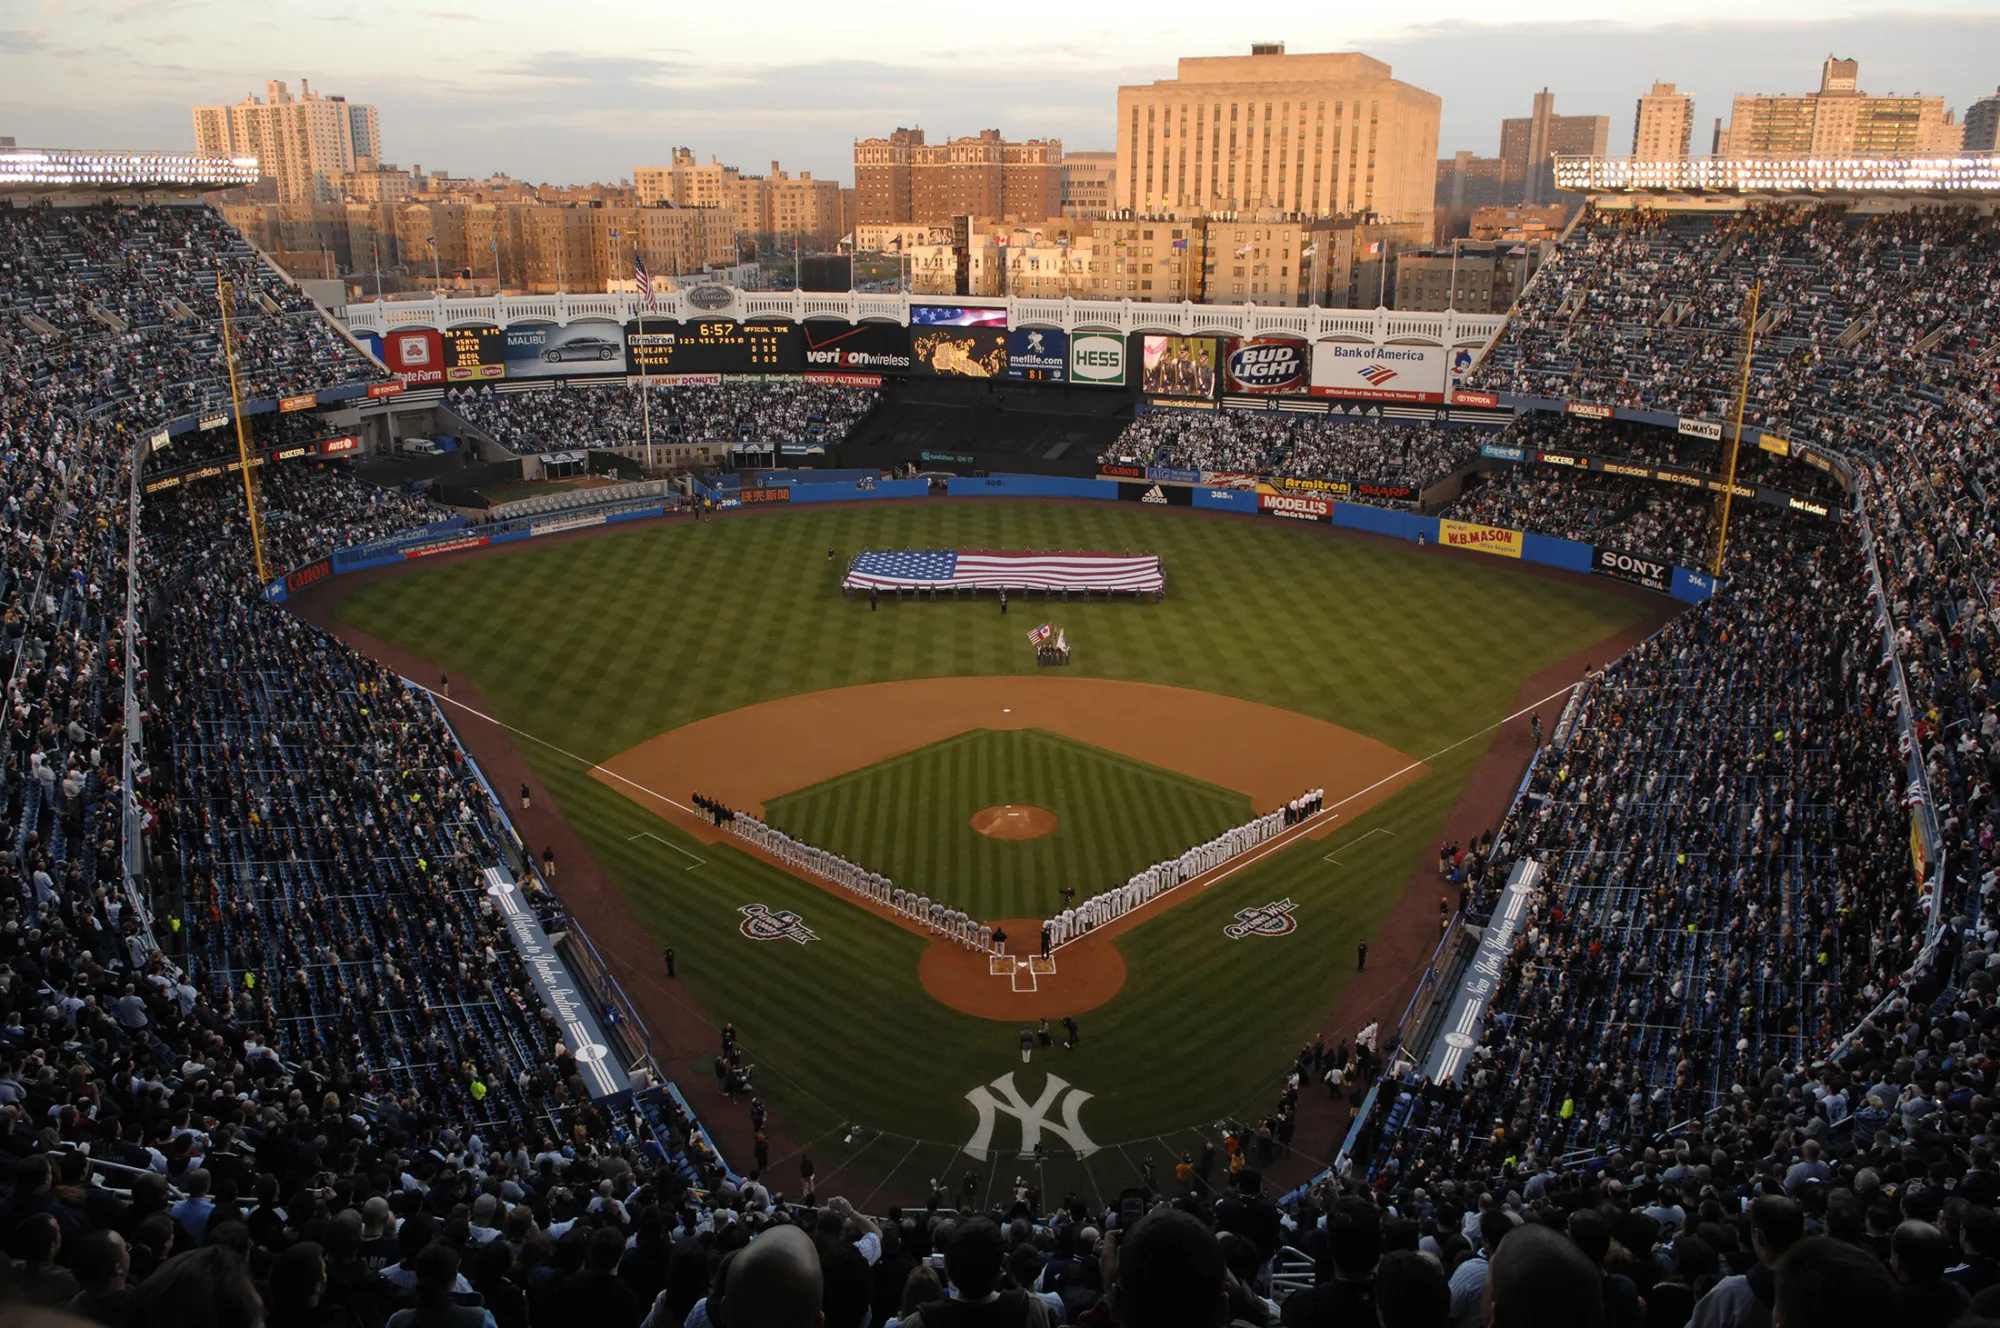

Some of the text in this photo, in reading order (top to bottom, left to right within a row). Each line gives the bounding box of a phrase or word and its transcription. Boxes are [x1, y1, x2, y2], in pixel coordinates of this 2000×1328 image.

[700, 324, 733, 336] 6:57
[508, 336, 545, 345] MALIBU
[630, 336, 673, 344] Armitron
[807, 348, 910, 366] verizon wireless
[1010, 355, 1063, 365] metlife.com
[1076, 350, 1119, 367] HESS
[1242, 348, 1293, 363] BUD
[1334, 347, 1424, 361] Bank of America
[1234, 360, 1300, 377] LIGHT
[682, 376, 718, 384] DONUTS
[836, 376, 882, 385] AUTHORITY
[380, 385, 400, 393] TOYOTA
[1568, 404, 1609, 416] MODELL'S
[1680, 422, 1719, 436] KOMATSU
[328, 441, 344, 451] AVIS
[280, 448, 304, 459] KYOCERA
[196, 467, 221, 478] adidas
[1102, 465, 1139, 476] Canon
[1151, 468, 1170, 480] AIG
[1618, 465, 1648, 477] adidas
[157, 477, 180, 489] adidas
[1209, 474, 1246, 484] Budweiser
[1285, 478, 1348, 491] Armitron
[1672, 474, 1700, 486] adidas
[1359, 484, 1410, 496] SHARP
[1142, 496, 1168, 504] adidas
[1264, 496, 1327, 514] MODELL'S
[1790, 498, 1828, 516] Foot Locker
[1602, 552, 1664, 579] SONY
[287, 561, 329, 592] Canon
[510, 913, 536, 944] Welcome
[1228, 915, 1270, 934] OPENING
[1466, 920, 1515, 1001] New York Yankees
[522, 954, 563, 984] Yankee
[548, 986, 580, 1021] Stadium
[963, 1071, 1101, 1162] NY
